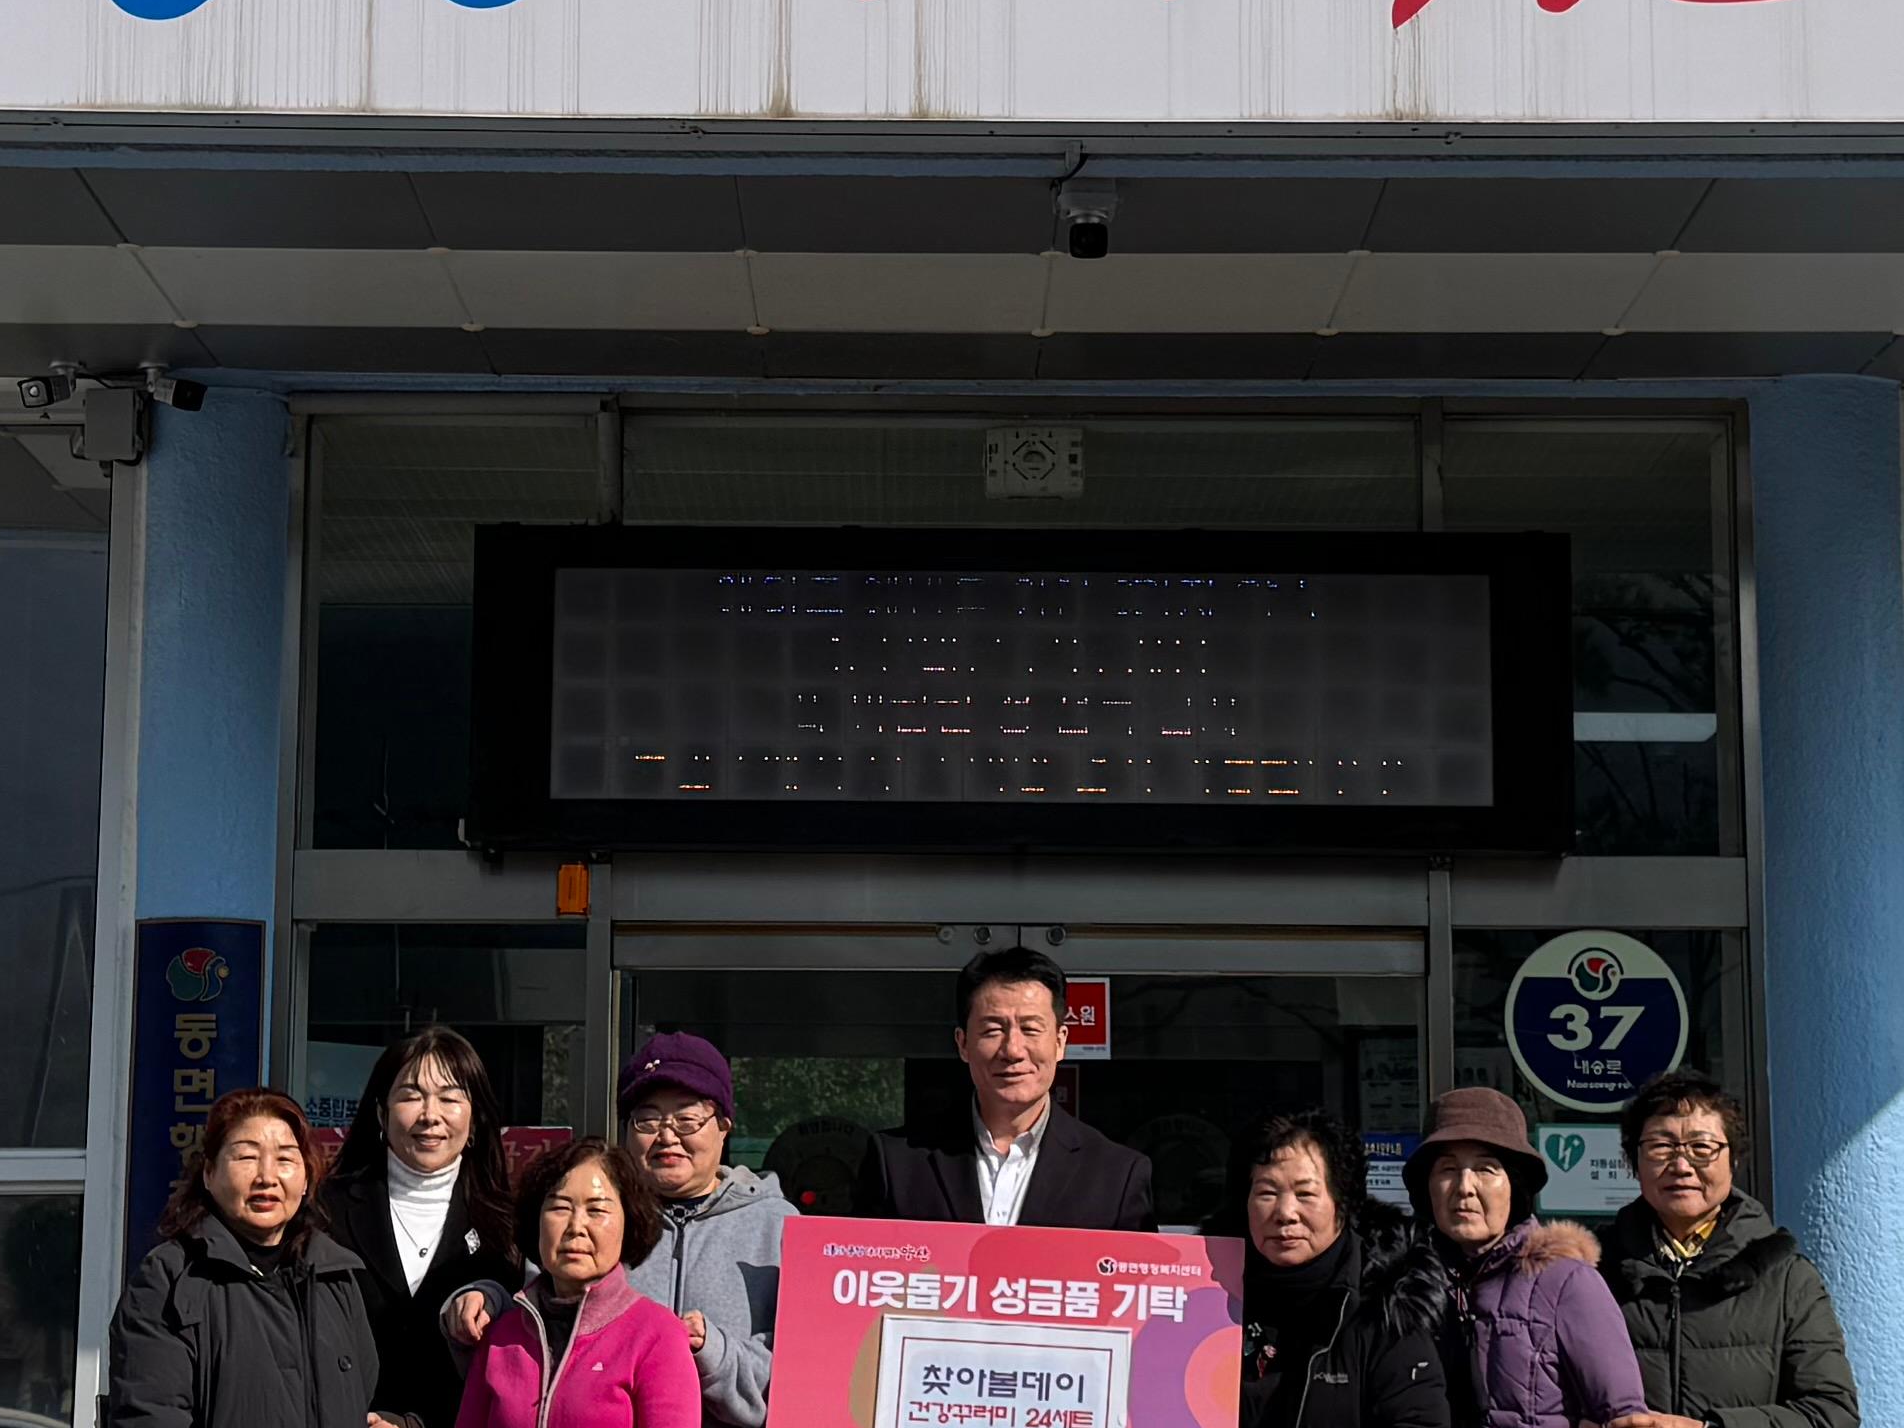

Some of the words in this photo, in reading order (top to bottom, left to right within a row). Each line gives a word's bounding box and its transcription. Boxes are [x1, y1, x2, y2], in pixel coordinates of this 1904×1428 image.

[1547, 1004, 1645, 1051] 37
[1574, 1060, 1621, 1075] 내송로
[833, 1268, 978, 1313] 이웃돕기
[989, 1278, 1100, 1319] 성금품
[1111, 1283, 1187, 1323] 기탁
[922, 1364, 1084, 1403] 찾아봄데이
[908, 1401, 1016, 1428] 건강꾸러미
